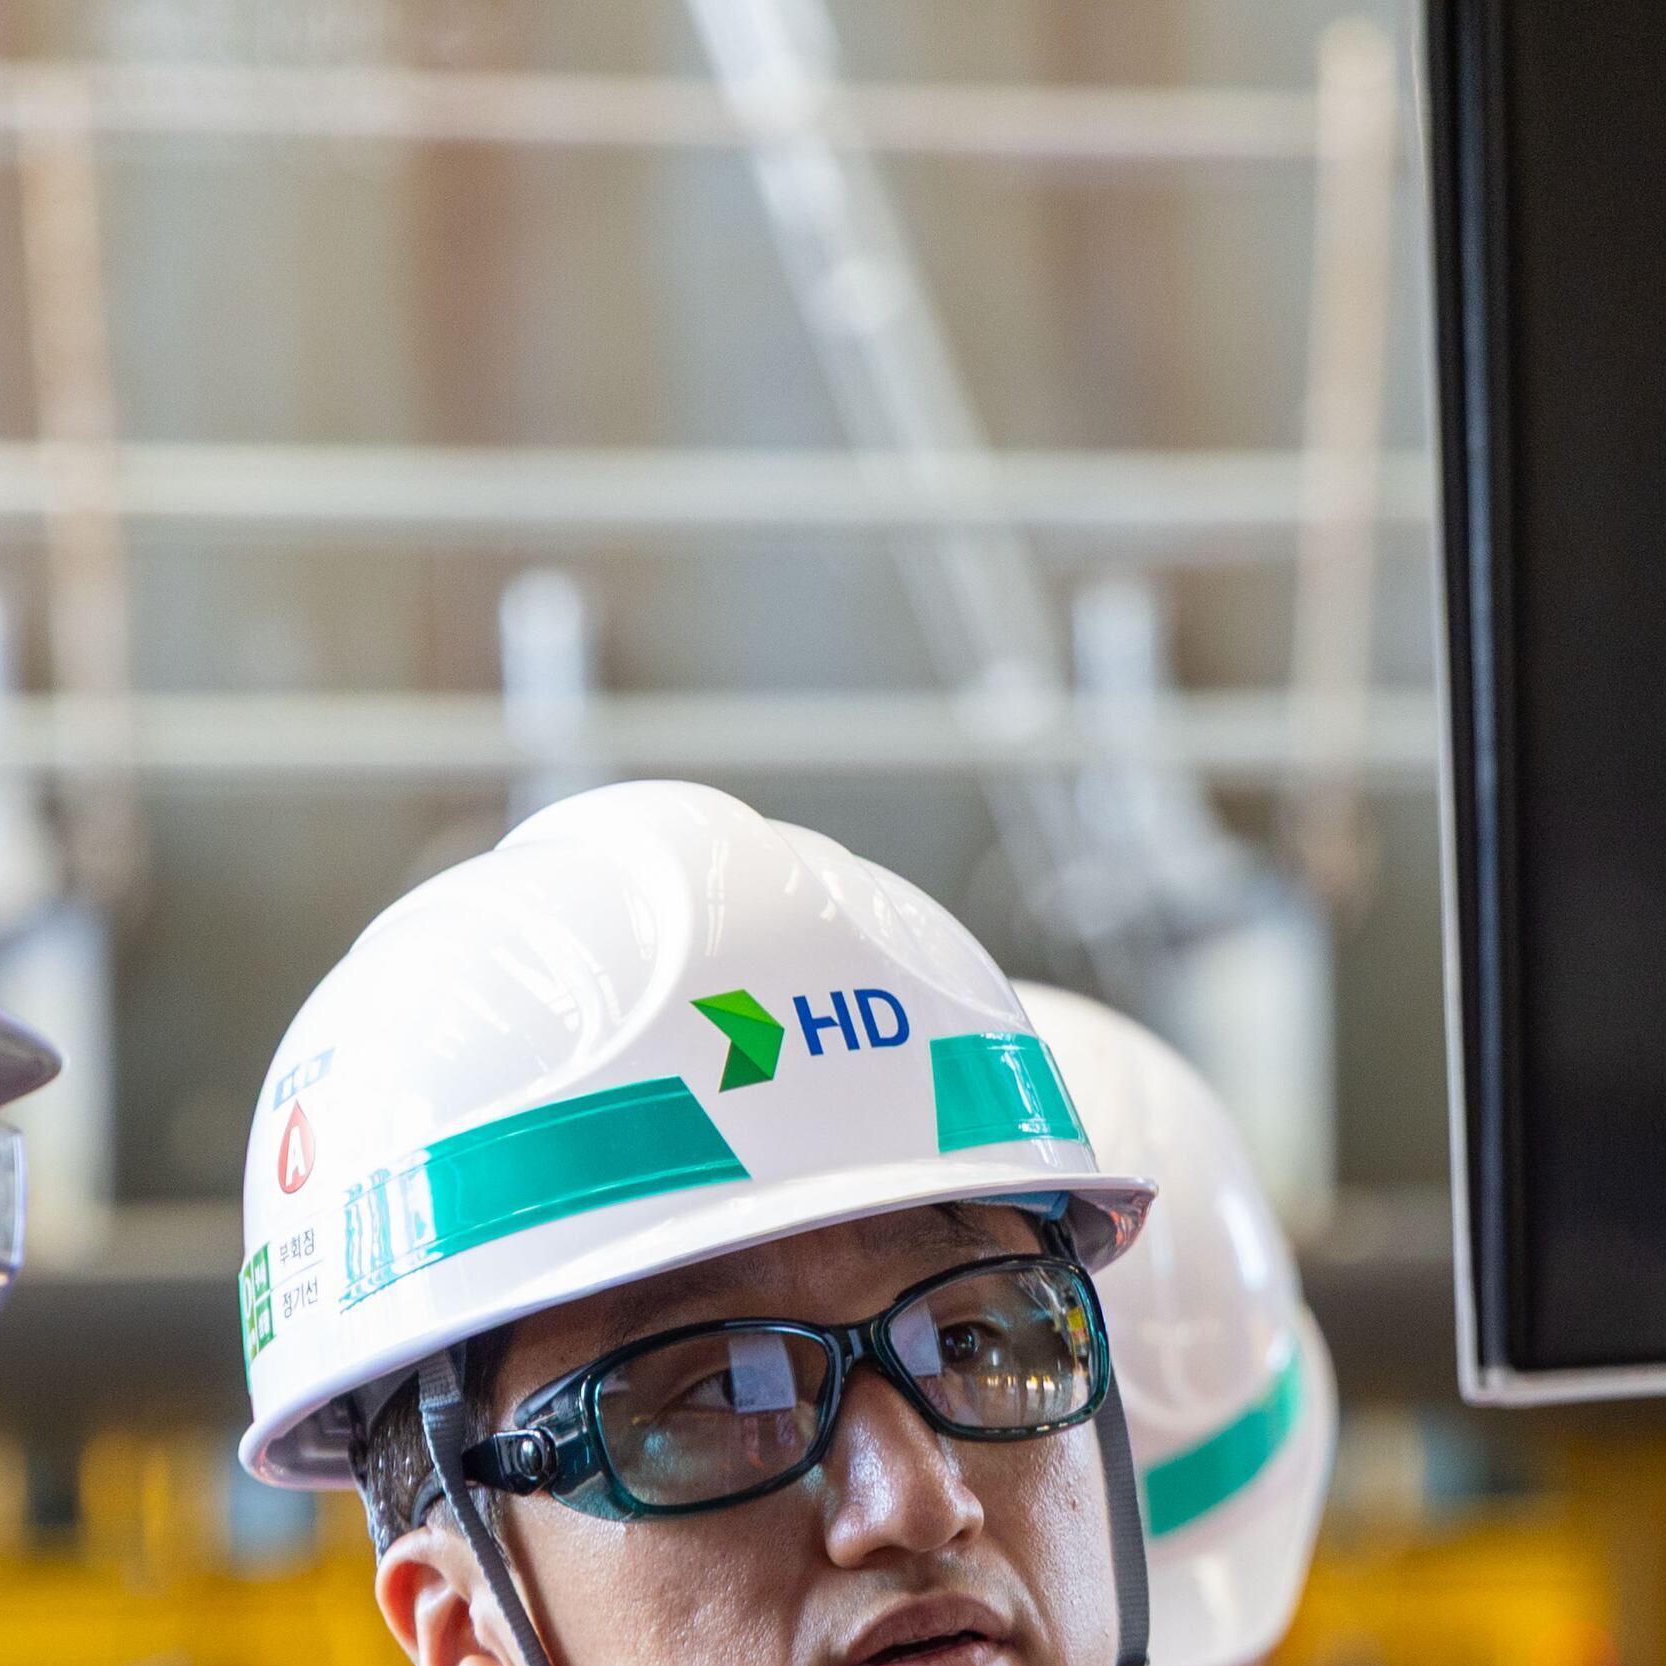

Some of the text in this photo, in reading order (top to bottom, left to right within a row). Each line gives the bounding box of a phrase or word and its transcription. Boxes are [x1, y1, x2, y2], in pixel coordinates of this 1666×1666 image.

[792, 987, 910, 1057] HD
[279, 1227, 315, 1265] 부회장
[282, 1276, 319, 1318] 정기선
